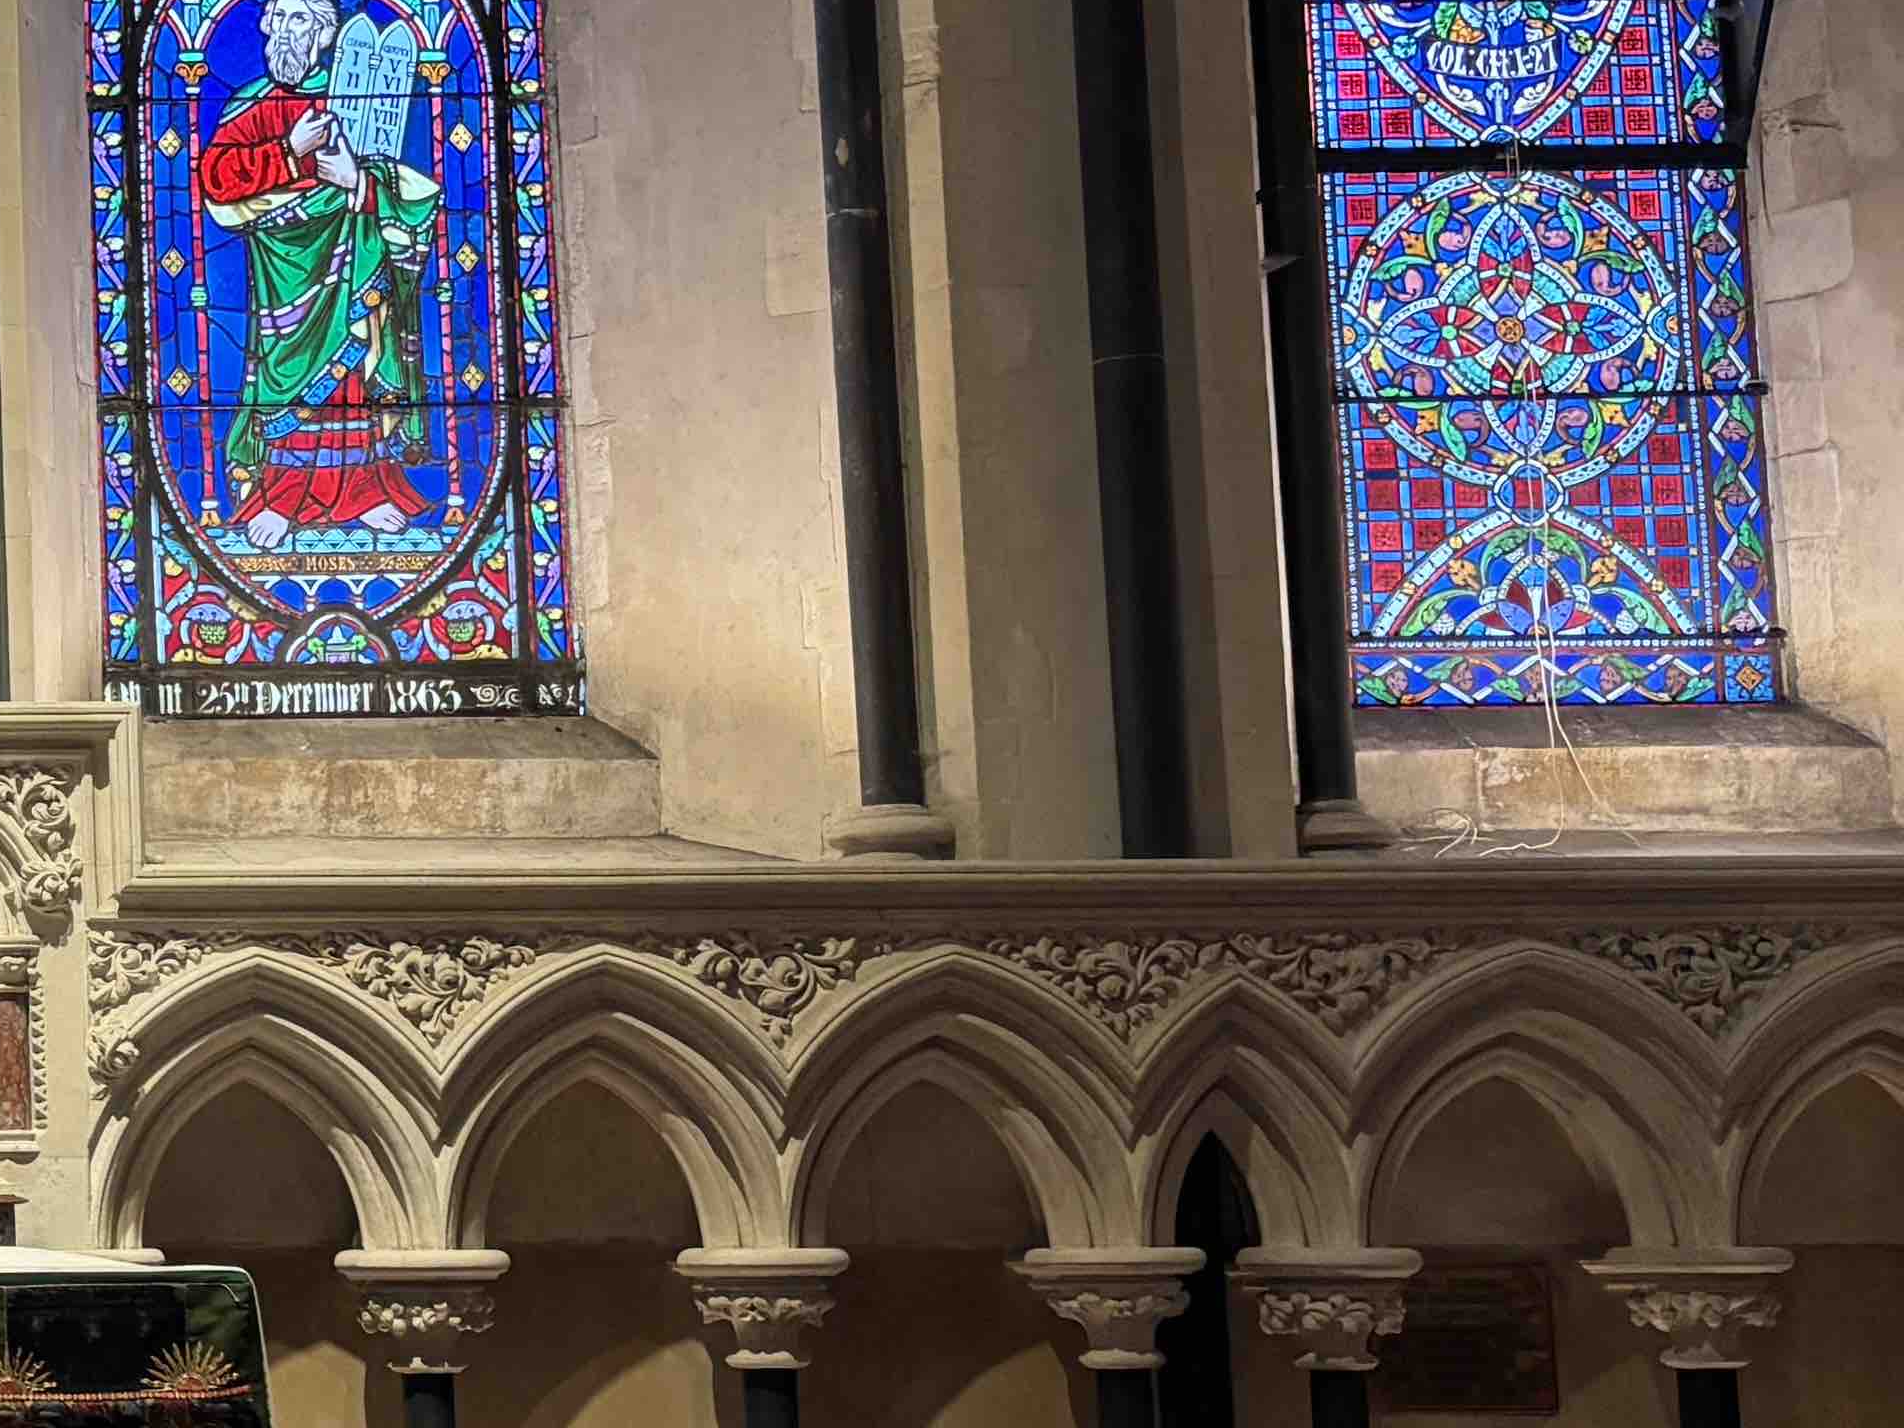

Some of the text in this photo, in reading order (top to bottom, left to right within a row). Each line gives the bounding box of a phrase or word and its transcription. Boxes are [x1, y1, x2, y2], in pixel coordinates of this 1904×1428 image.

[352, 50, 360, 66] I
[389, 58, 402, 73] V
[347, 72, 361, 89] II
[383, 74, 401, 93] VI
[374, 108, 399, 126] VIII
[374, 126, 393, 147] IX
[305, 555, 355, 571] MOSES
[251, 681, 373, 714] December
[384, 678, 462, 714] 1863
